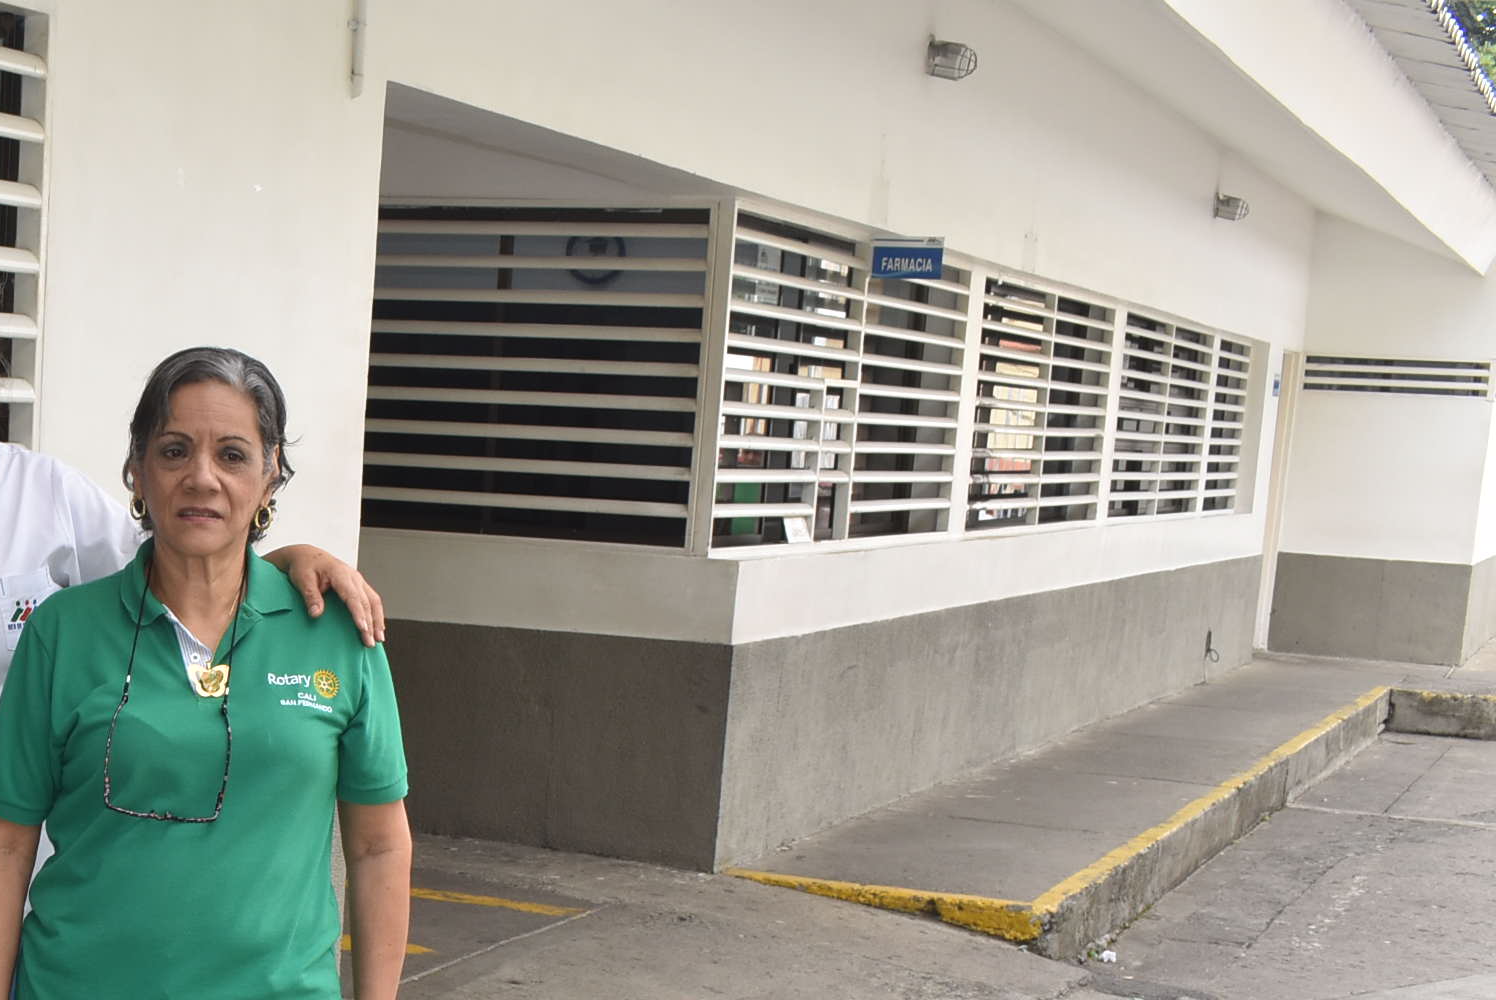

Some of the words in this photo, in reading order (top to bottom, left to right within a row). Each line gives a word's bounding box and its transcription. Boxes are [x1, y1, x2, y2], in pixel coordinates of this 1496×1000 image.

[880, 256, 934, 273] FARMACIA
[267, 672, 311, 688] Rotary
[297, 691, 317, 702] CALI
[297, 699, 333, 713] FERNANDO
